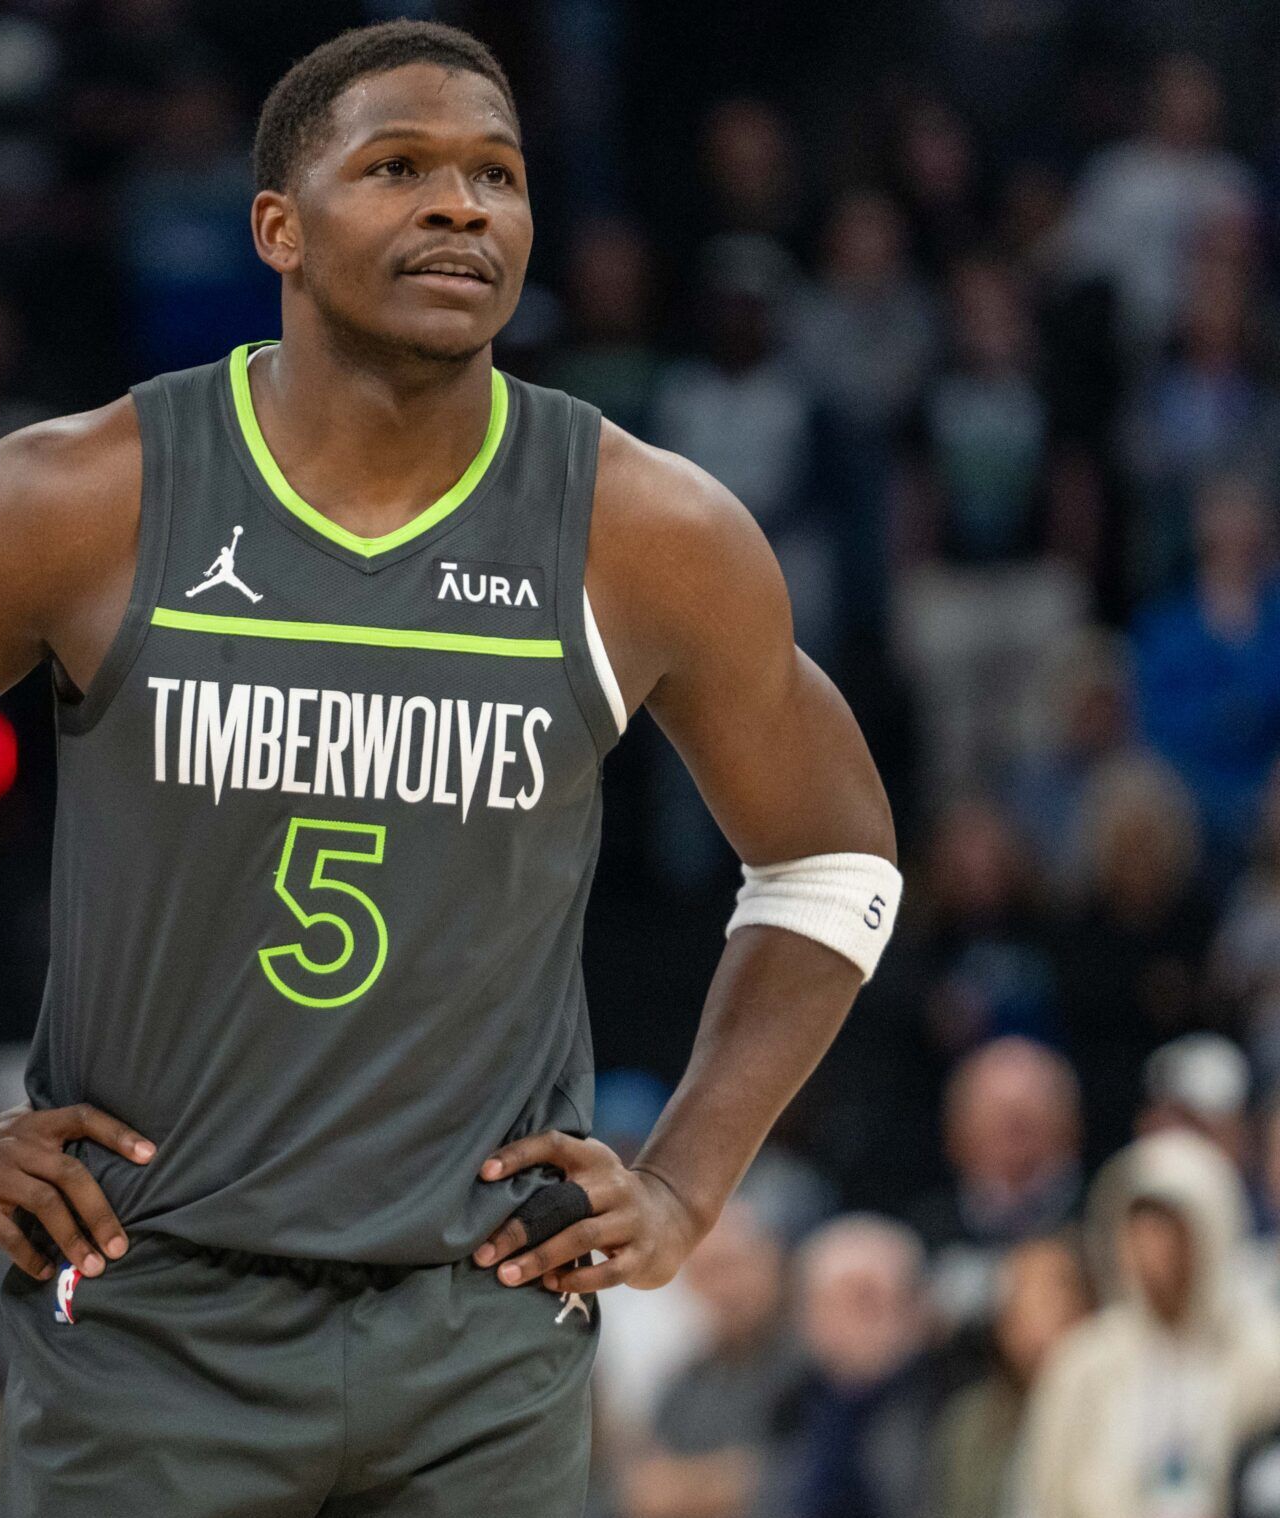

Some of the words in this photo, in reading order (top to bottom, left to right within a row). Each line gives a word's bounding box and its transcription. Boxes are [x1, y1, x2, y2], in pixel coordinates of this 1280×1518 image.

[148, 677, 552, 824] TIMBERWOLVES
[258, 817, 388, 1008] 5
[863, 894, 886, 930] 5
